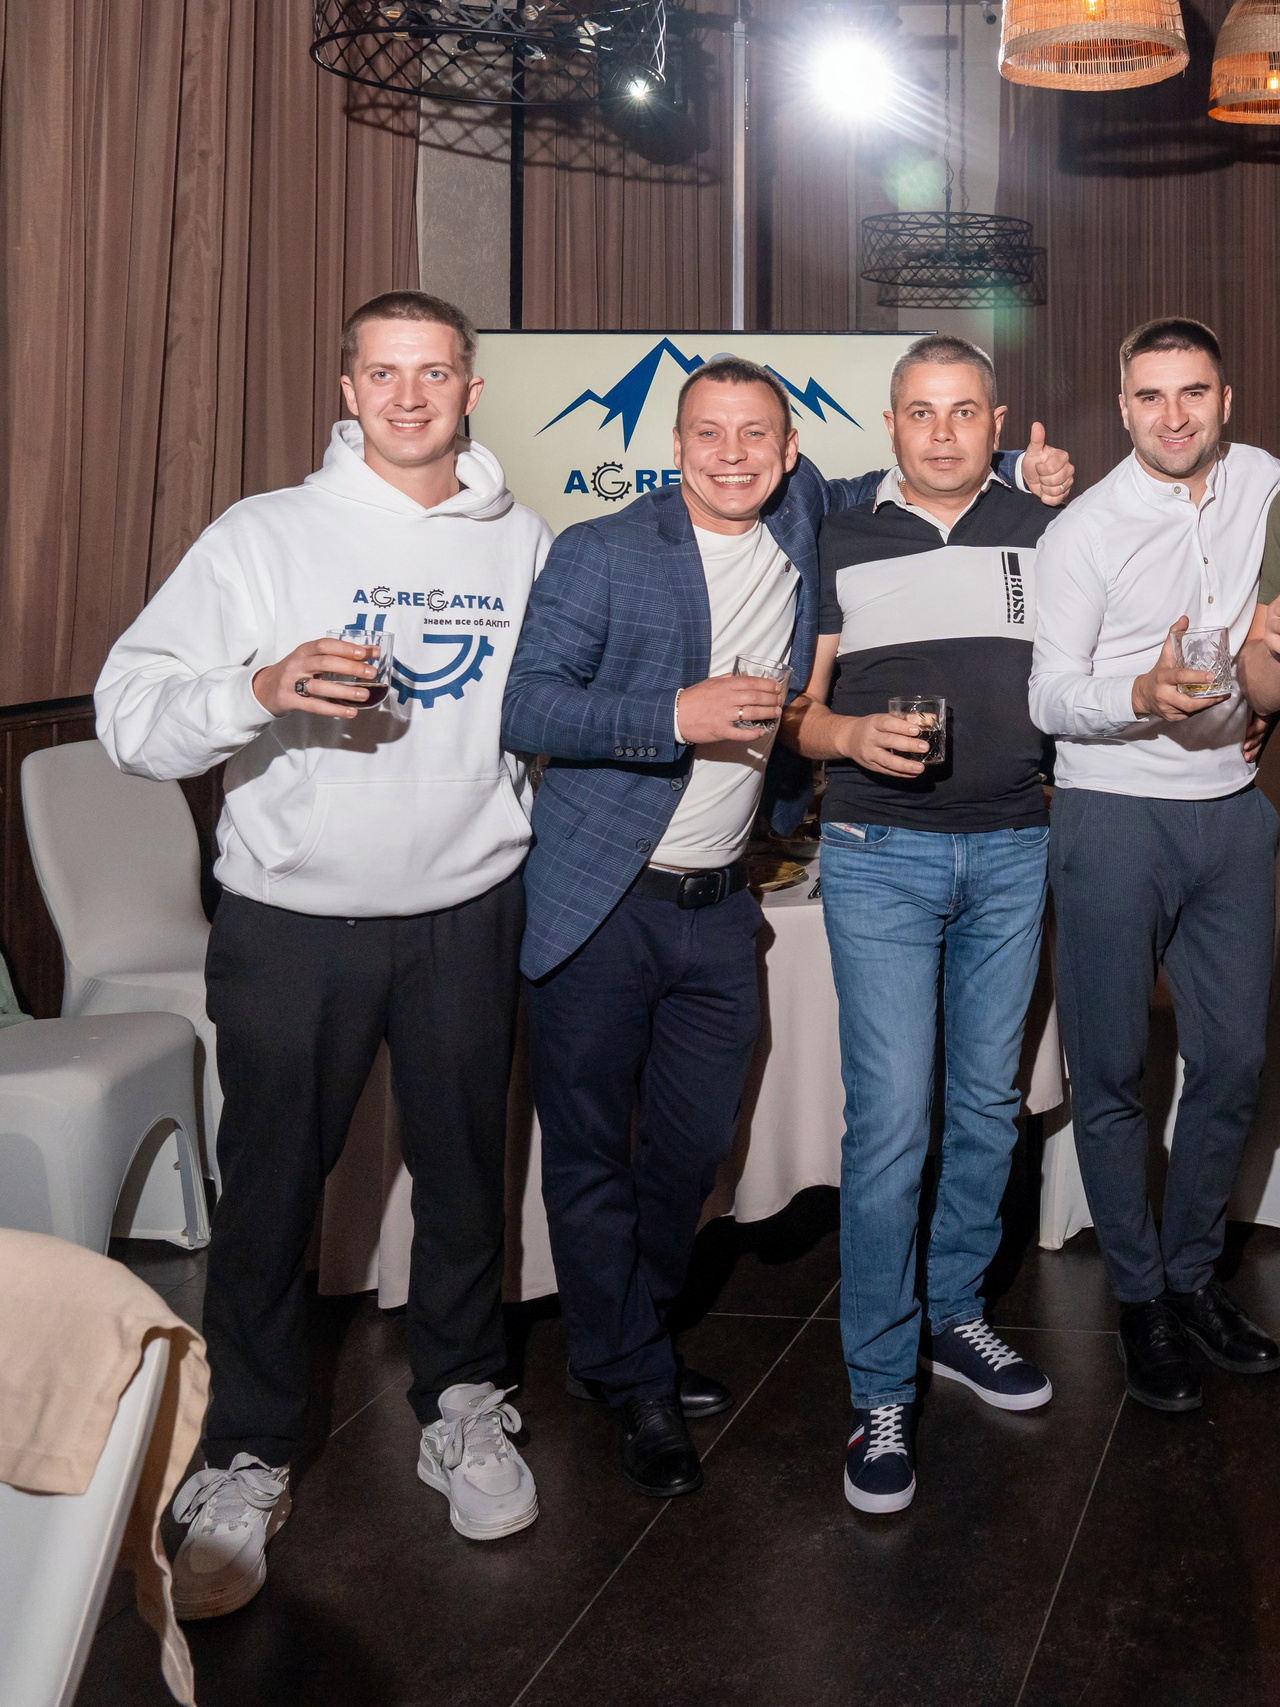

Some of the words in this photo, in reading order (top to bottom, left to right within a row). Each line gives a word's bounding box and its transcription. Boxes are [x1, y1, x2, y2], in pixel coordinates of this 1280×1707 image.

[563, 461, 682, 502] AGRE
[352, 585, 505, 612] AGREGATKA
[1010, 576, 1025, 625] BOSS
[423, 617, 452, 625] знаем
[455, 618, 472, 626] все
[473, 618, 484, 626] об
[485, 619, 510, 628] АКПП
